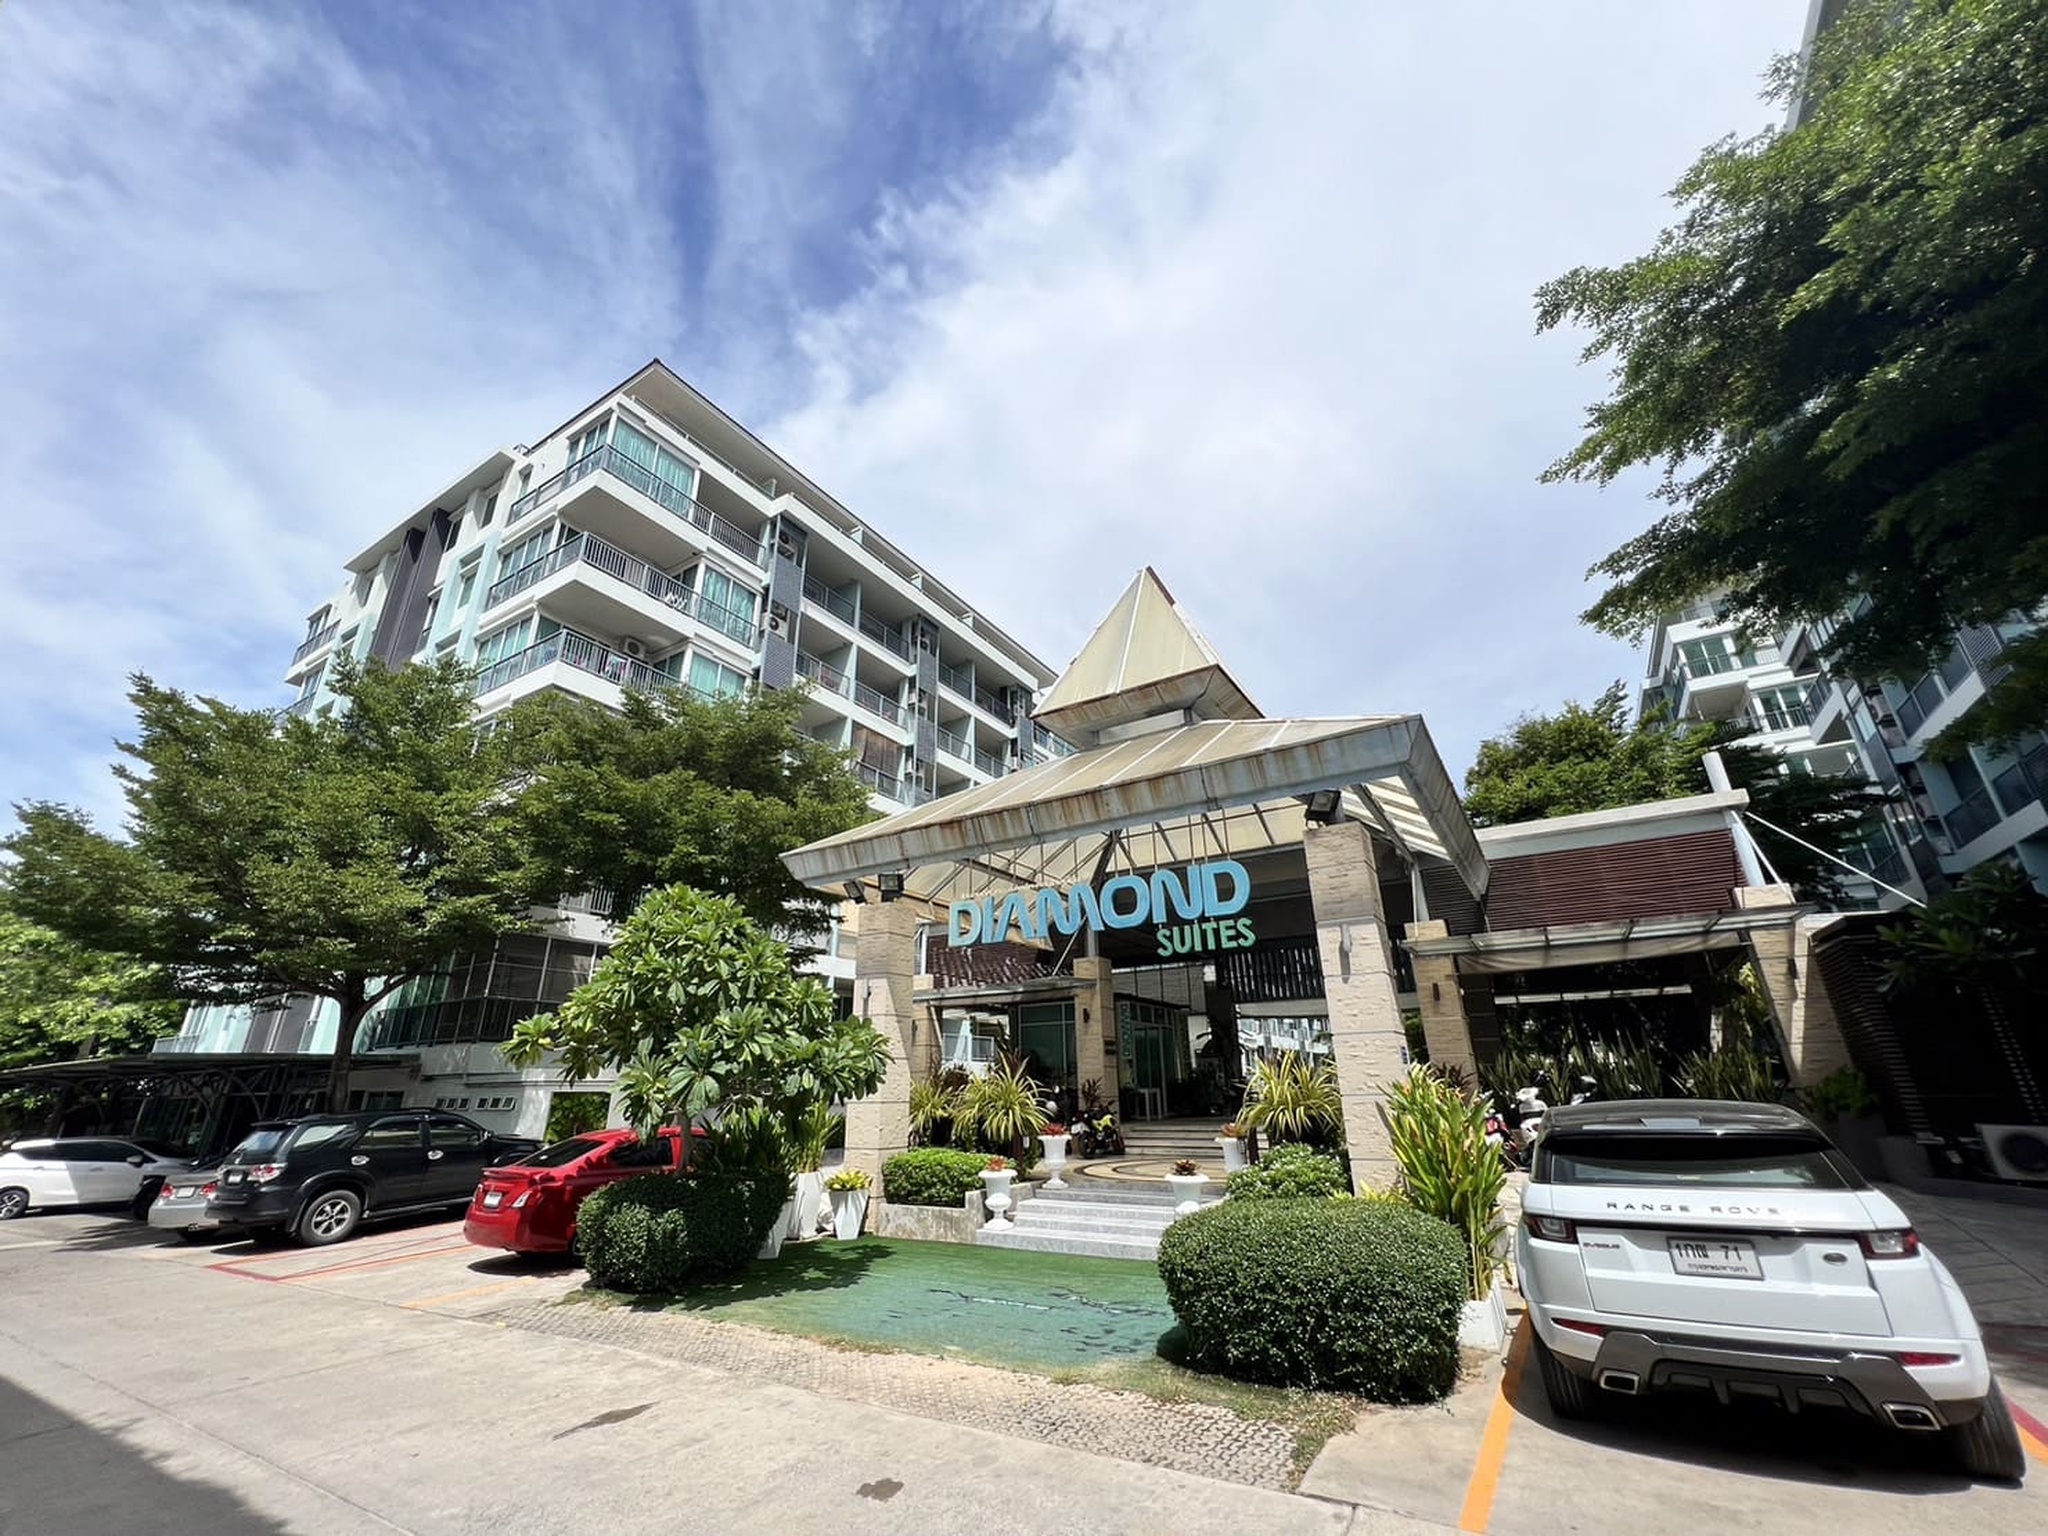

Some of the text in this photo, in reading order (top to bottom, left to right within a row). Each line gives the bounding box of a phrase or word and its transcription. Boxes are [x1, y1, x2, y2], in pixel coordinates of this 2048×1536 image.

[949, 859, 1250, 947] DIAMOND
[1156, 918, 1257, 957] SUITES
[1606, 1201, 1796, 1215] RANGE ROVE
[1720, 1244, 1742, 1261] 71
